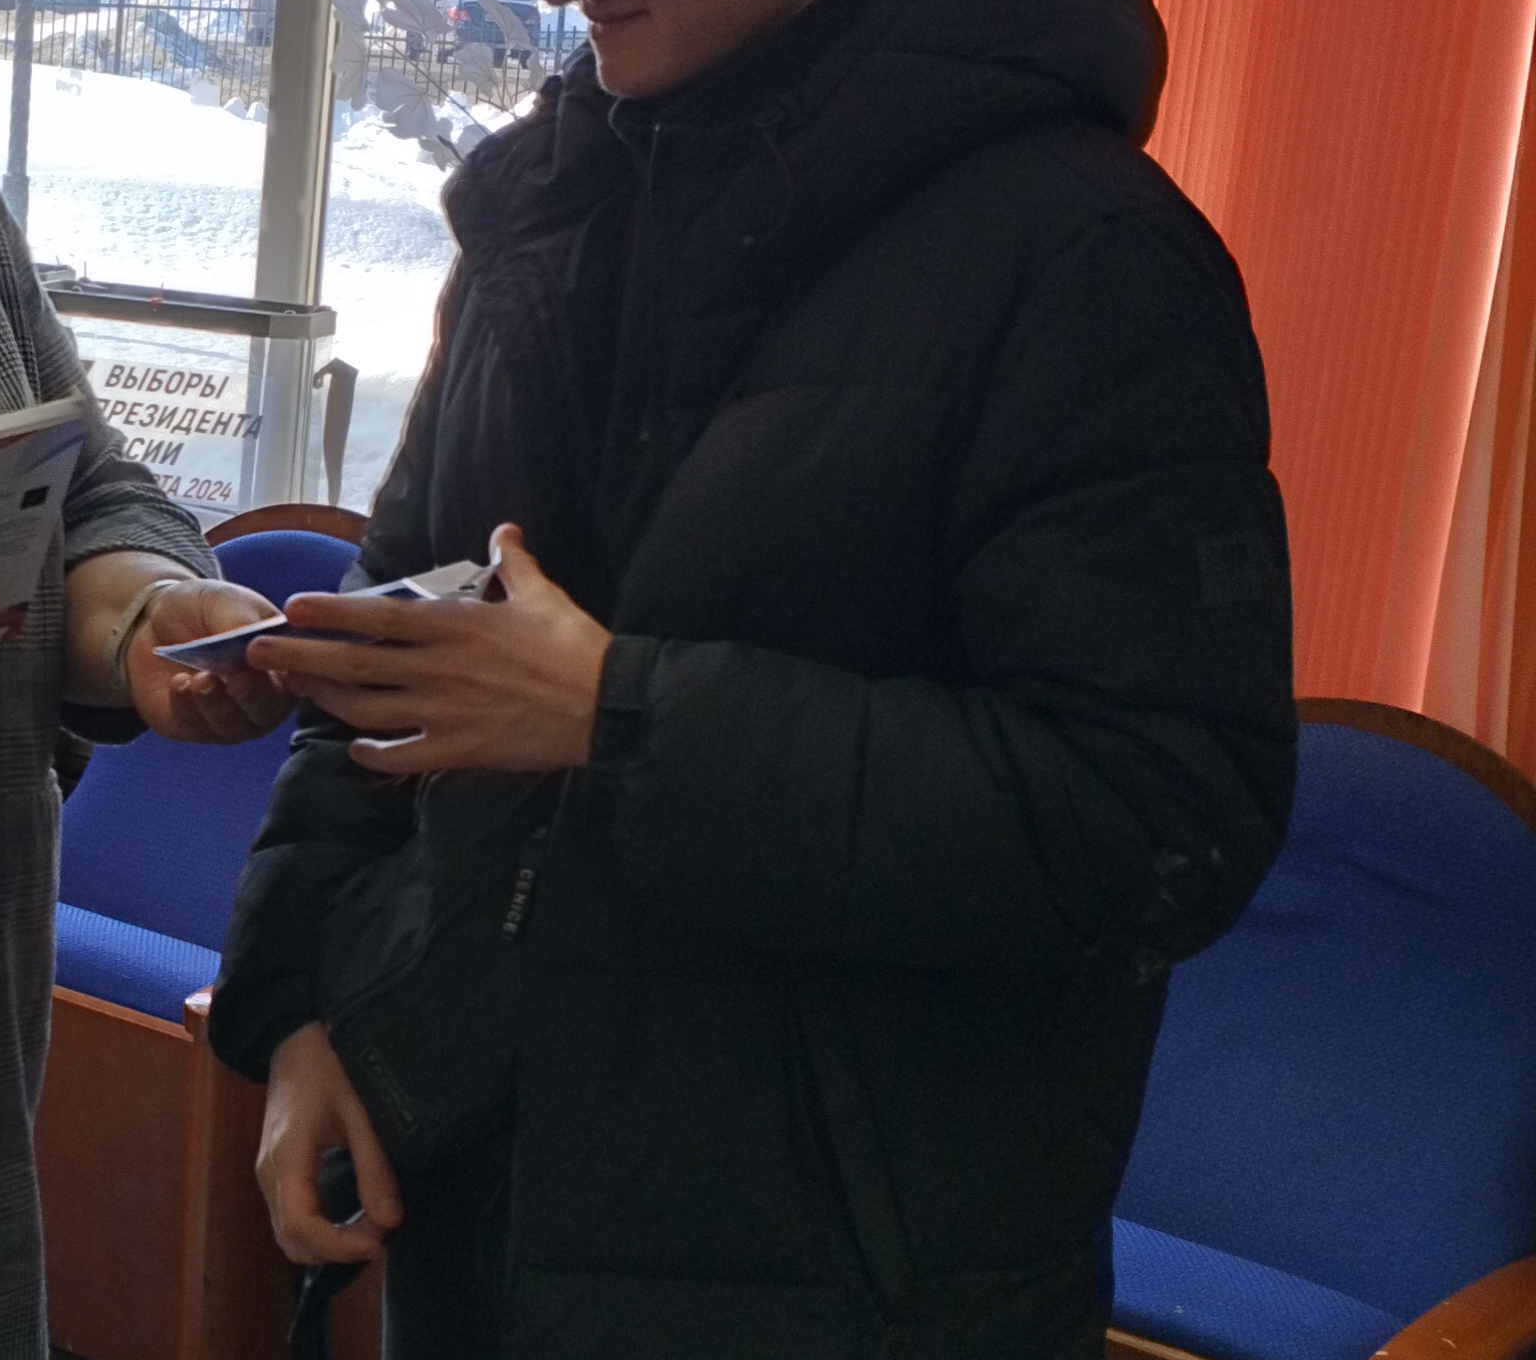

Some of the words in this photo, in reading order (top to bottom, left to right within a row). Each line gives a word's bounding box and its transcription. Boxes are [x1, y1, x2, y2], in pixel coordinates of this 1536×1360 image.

[104, 364, 230, 400] ВЫБОРЫ
[125, 437, 185, 466] СИИ
[182, 478, 233, 503] 2024
